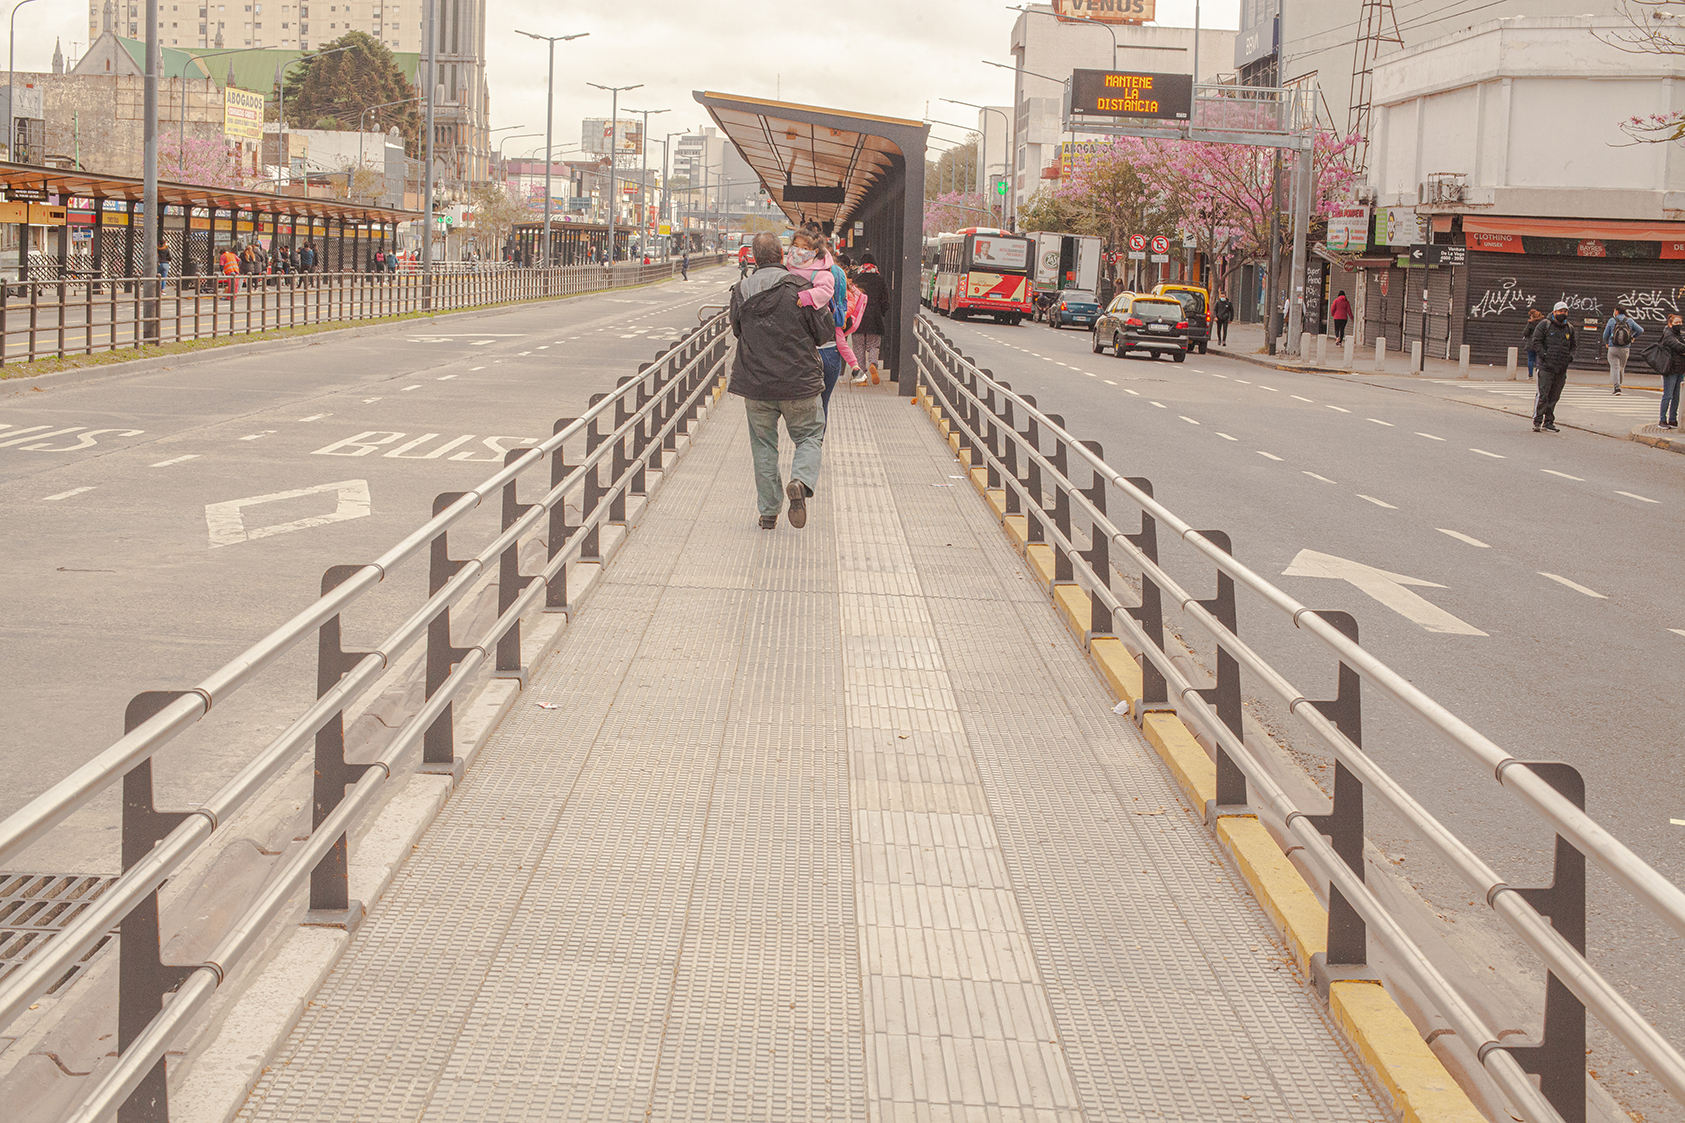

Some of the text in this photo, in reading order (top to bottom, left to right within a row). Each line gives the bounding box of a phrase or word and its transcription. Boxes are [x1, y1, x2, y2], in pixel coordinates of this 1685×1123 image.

[1072, 0, 1144, 14] VENUS
[1246, 32, 1259, 56] BBVA
[1105, 75, 1153, 89] MANTENE
[227, 91, 263, 110] ABOGADOS
[1124, 88, 1139, 100] LA
[1097, 98, 1158, 112] DISTANCIA
[1064, 143, 1114, 154] ABOGAOS
[1473, 233, 1512, 242] CLOTHING
[974, 286, 980, 294] 9
[0, 423, 145, 452] US
[309, 431, 539, 462] BUS
